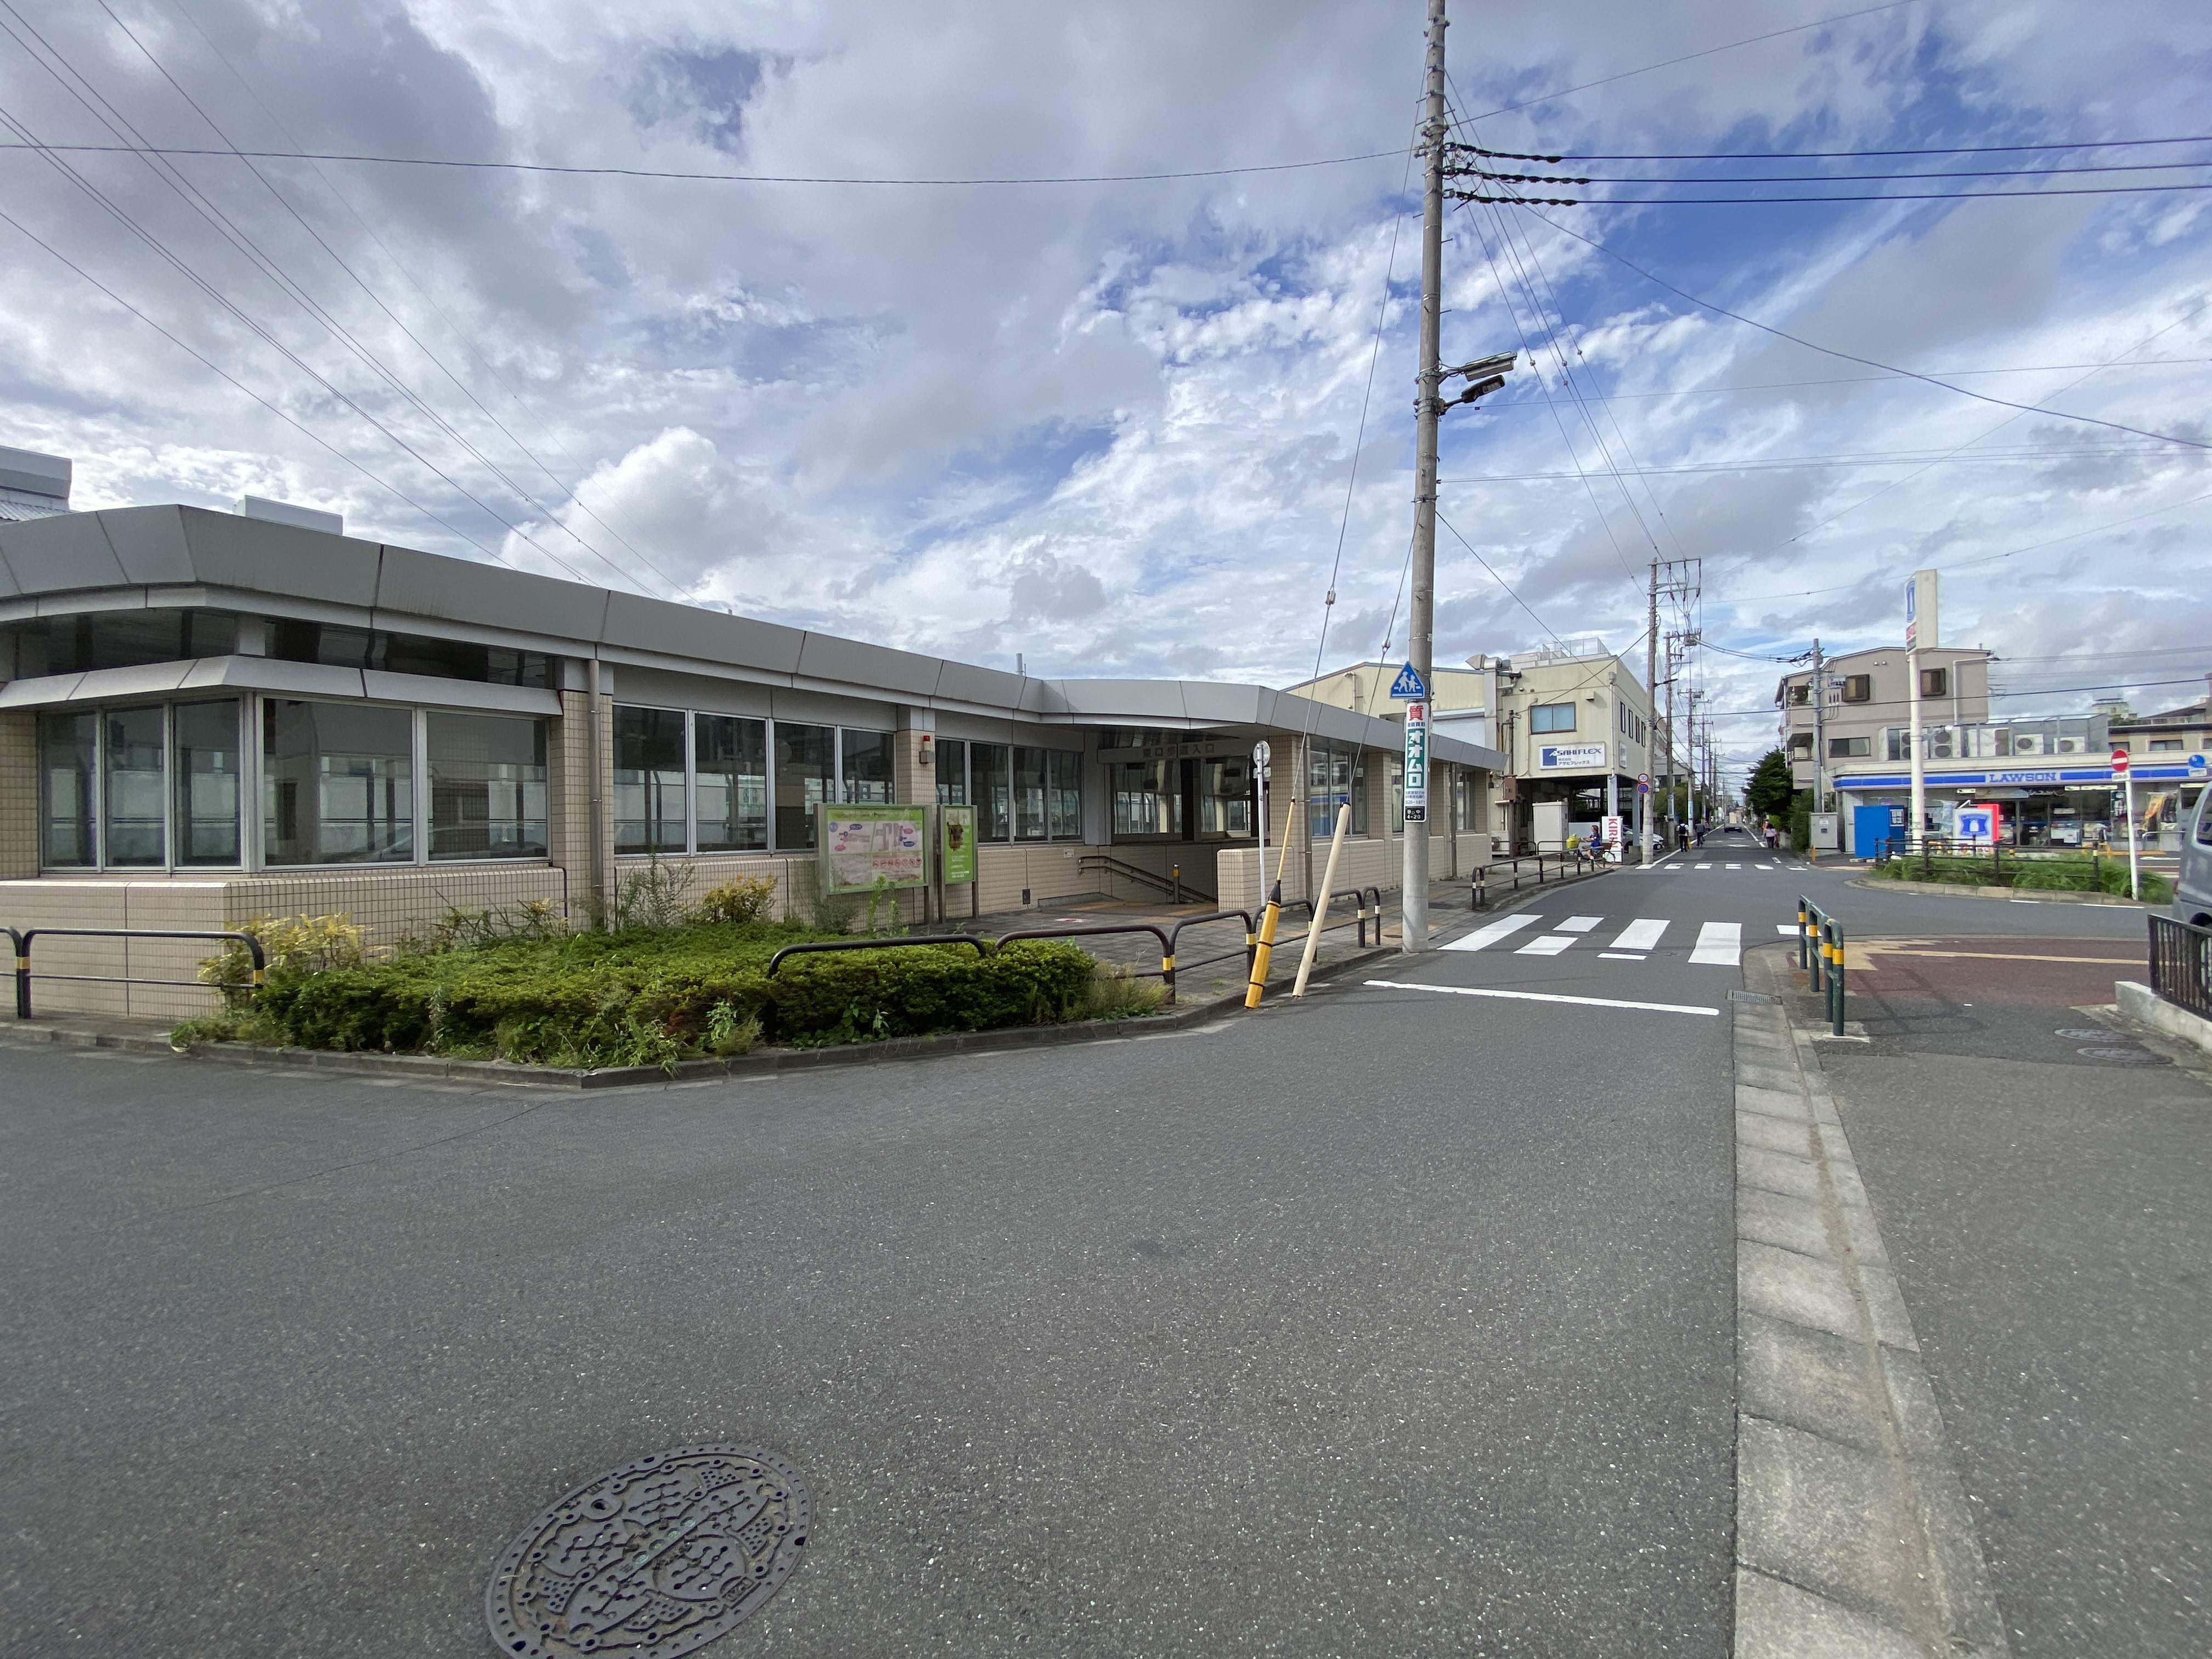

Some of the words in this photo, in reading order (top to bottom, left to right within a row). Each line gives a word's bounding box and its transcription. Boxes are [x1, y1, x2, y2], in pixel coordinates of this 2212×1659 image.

[1409, 706, 1424, 721] 質
[1408, 730, 1423, 787] オオムロ
[1989, 772, 2057, 782] LAWSON
